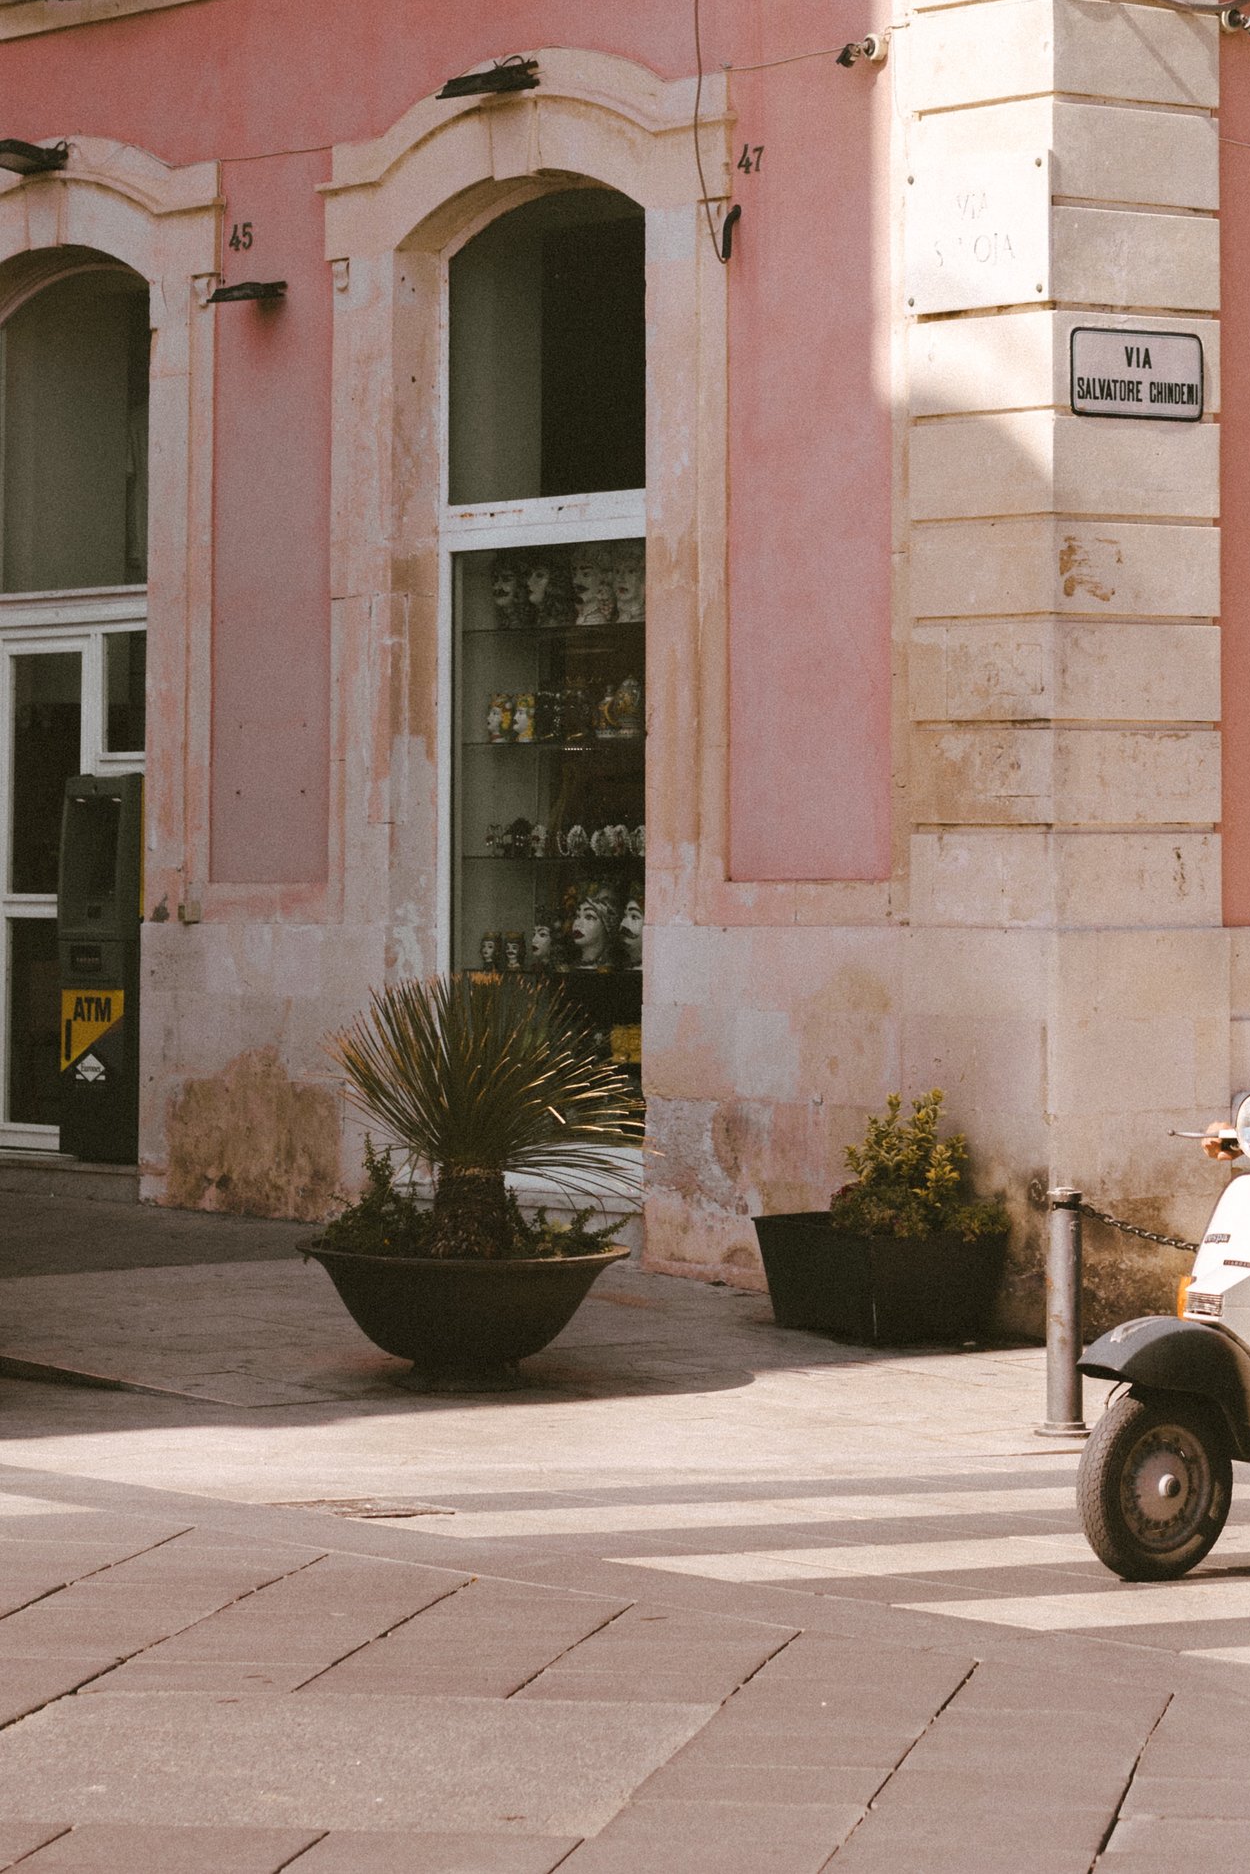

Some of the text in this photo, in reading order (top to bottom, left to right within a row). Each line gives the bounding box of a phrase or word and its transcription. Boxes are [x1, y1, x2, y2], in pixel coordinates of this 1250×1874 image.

[737, 143, 765, 174] 47
[229, 221, 253, 251] 45
[1124, 346, 1152, 369] VIA
[1077, 377, 1199, 406] SALVATORE CHINDEMI
[73, 996, 112, 1023] ATM
